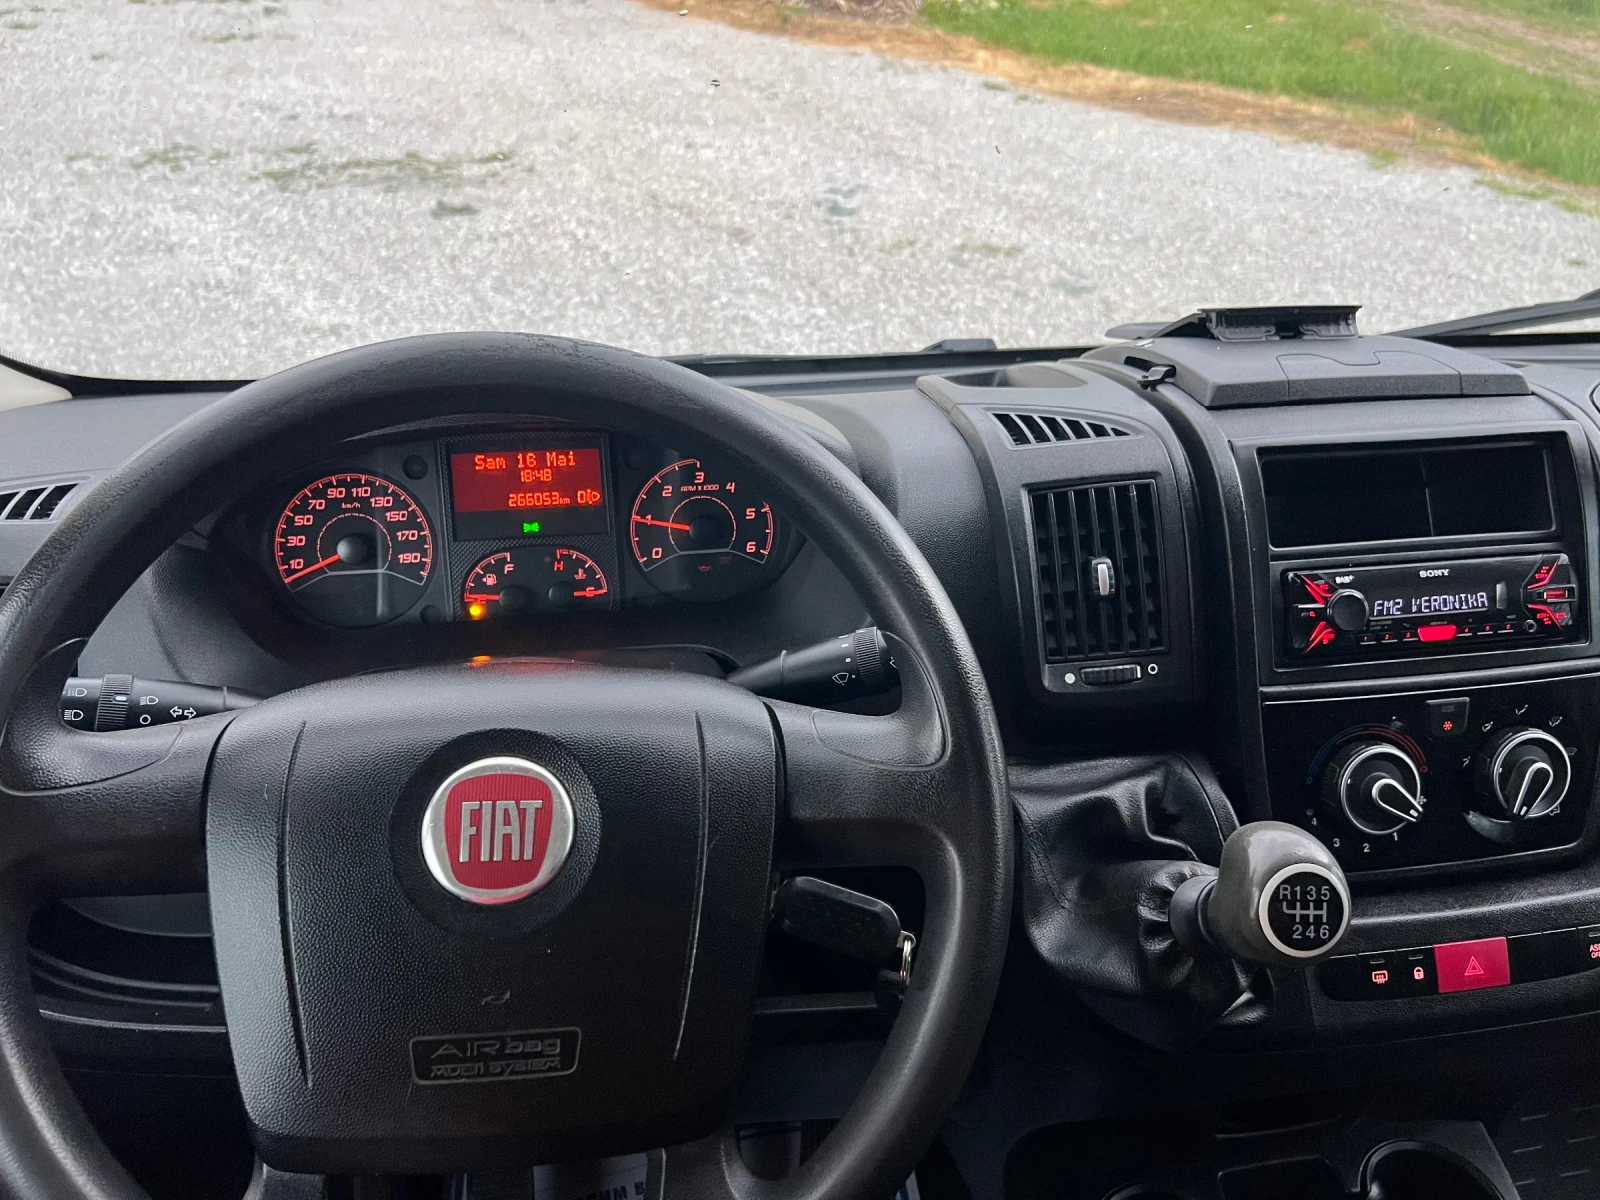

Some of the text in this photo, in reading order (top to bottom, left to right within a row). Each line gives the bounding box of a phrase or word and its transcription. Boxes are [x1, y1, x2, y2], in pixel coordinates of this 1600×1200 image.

[475, 450, 576, 470] Sam 16 Mai
[520, 469, 552, 482] 18:48
[694, 472, 704, 482] 3
[351, 486, 370, 497] 110
[661, 485, 672, 496] 2
[725, 482, 735, 492] 4
[326, 488, 345, 498] 90
[308, 499, 325, 510] 70
[369, 496, 393, 507] 130
[385, 510, 407, 521] 150
[745, 507, 755, 518] 5
[293, 514, 313, 525] 50
[286, 535, 305, 546] 30
[396, 531, 417, 542] 170
[745, 541, 756, 552] 6
[397, 552, 420, 563] 190
[652, 547, 662, 558] 0
[289, 558, 303, 569] 10
[504, 563, 514, 574] F
[554, 561, 563, 571] H
[1419, 568, 1450, 578] SONY
[1373, 591, 1488, 617] FM2 VERONIKA
[1310, 815, 1318, 826] 4
[459, 799, 544, 863] FIAT
[1391, 831, 1399, 841] 1
[1332, 837, 1341, 849] 3
[1362, 842, 1371, 853] 2
